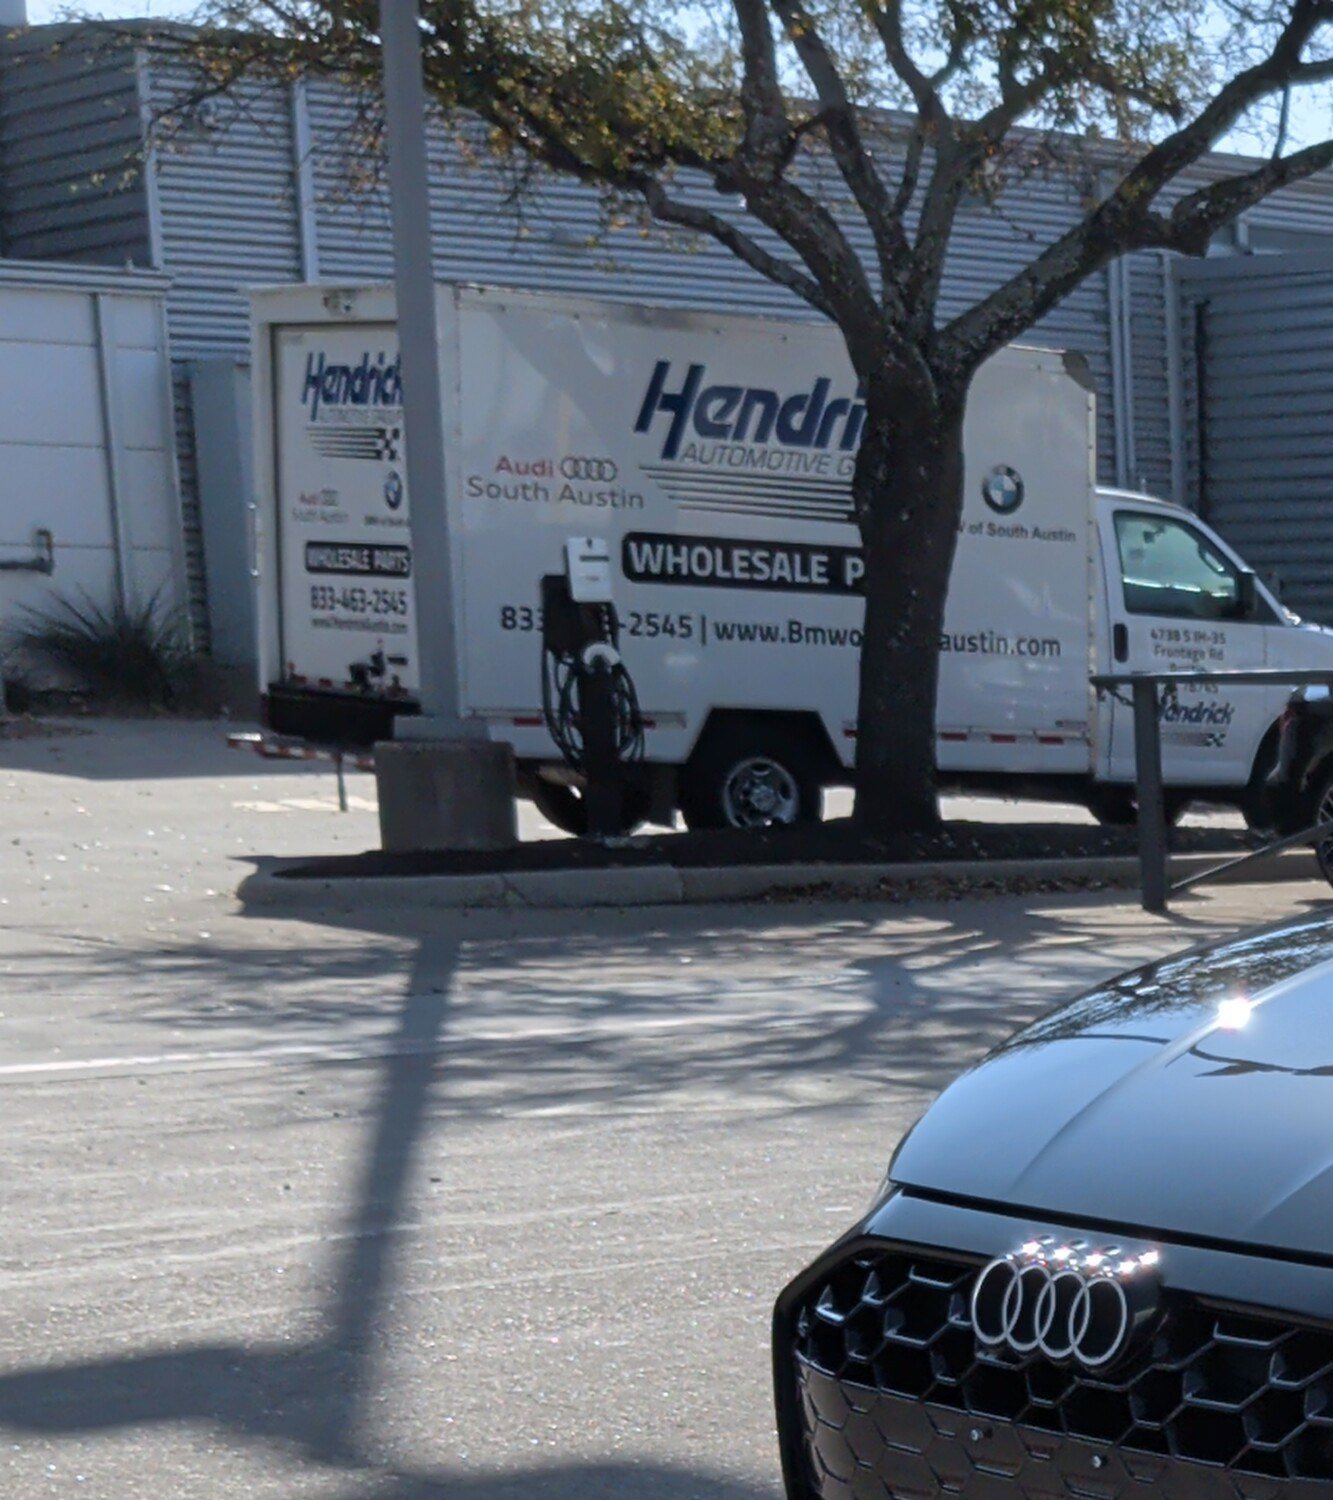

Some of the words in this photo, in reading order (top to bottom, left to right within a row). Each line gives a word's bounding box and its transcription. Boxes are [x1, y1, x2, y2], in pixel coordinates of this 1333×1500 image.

[634, 361, 866, 460] Hendri
[495, 456, 554, 477] Audi
[680, 443, 831, 475] AUTOMOTIVE
[467, 476, 549, 502] South
[555, 484, 644, 509] Austin
[969, 523, 984, 534] of
[988, 523, 1029, 539] South
[1032, 527, 1077, 542] Austin
[308, 548, 371, 570] WHOLESALE
[628, 541, 829, 584] WHOLESALE
[501, 605, 693, 640] 83-2545
